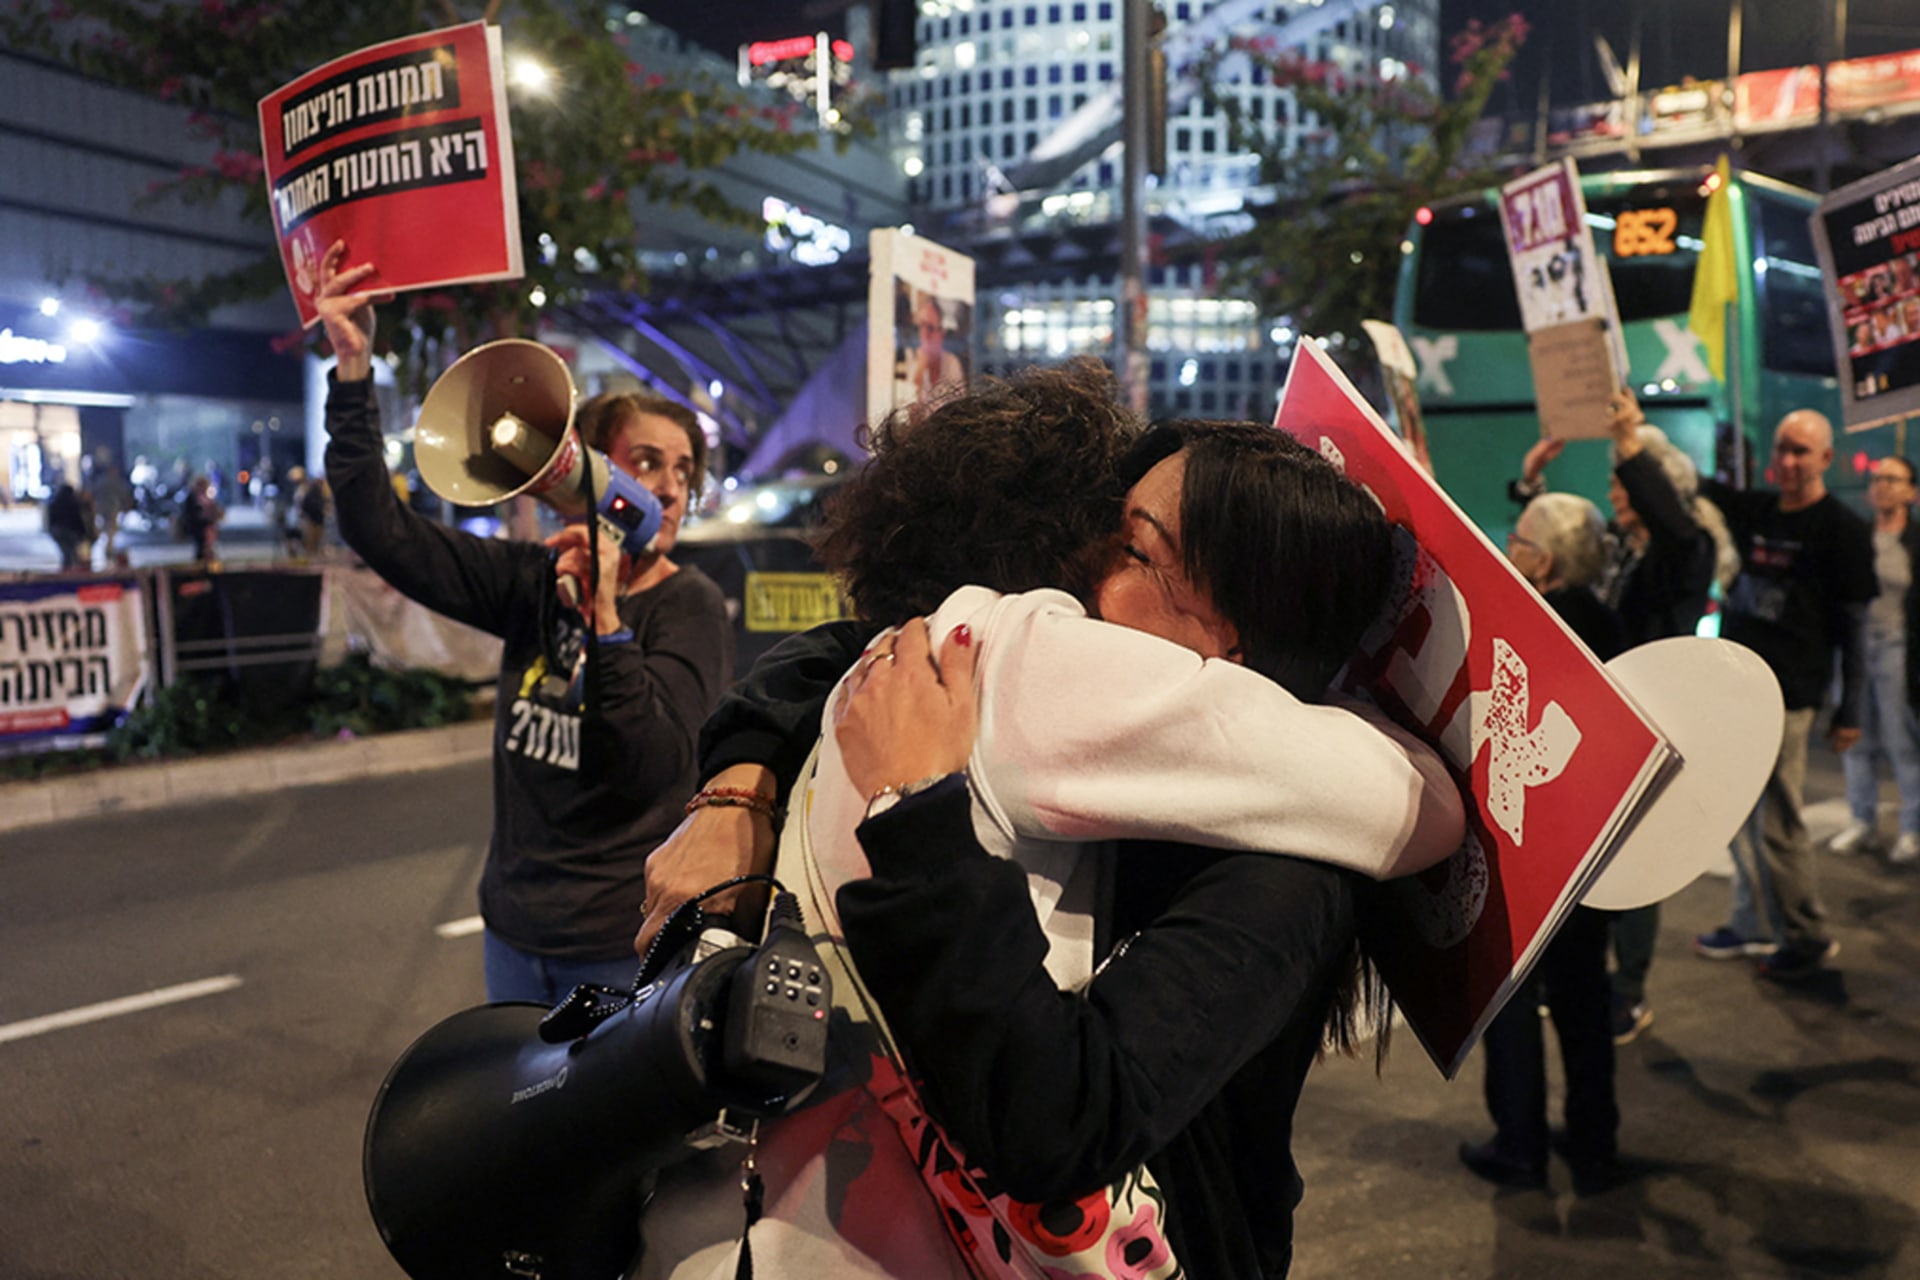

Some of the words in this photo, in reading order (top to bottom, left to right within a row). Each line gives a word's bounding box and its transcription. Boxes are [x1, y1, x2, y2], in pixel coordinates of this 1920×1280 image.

[357, 61, 444, 118] תמונת
[282, 83, 351, 152] הניצחון
[334, 140, 424, 199] החטוף
[430, 129, 489, 178] היא
[1614, 207, 1678, 258] 852
[0, 656, 111, 704] הביתה
